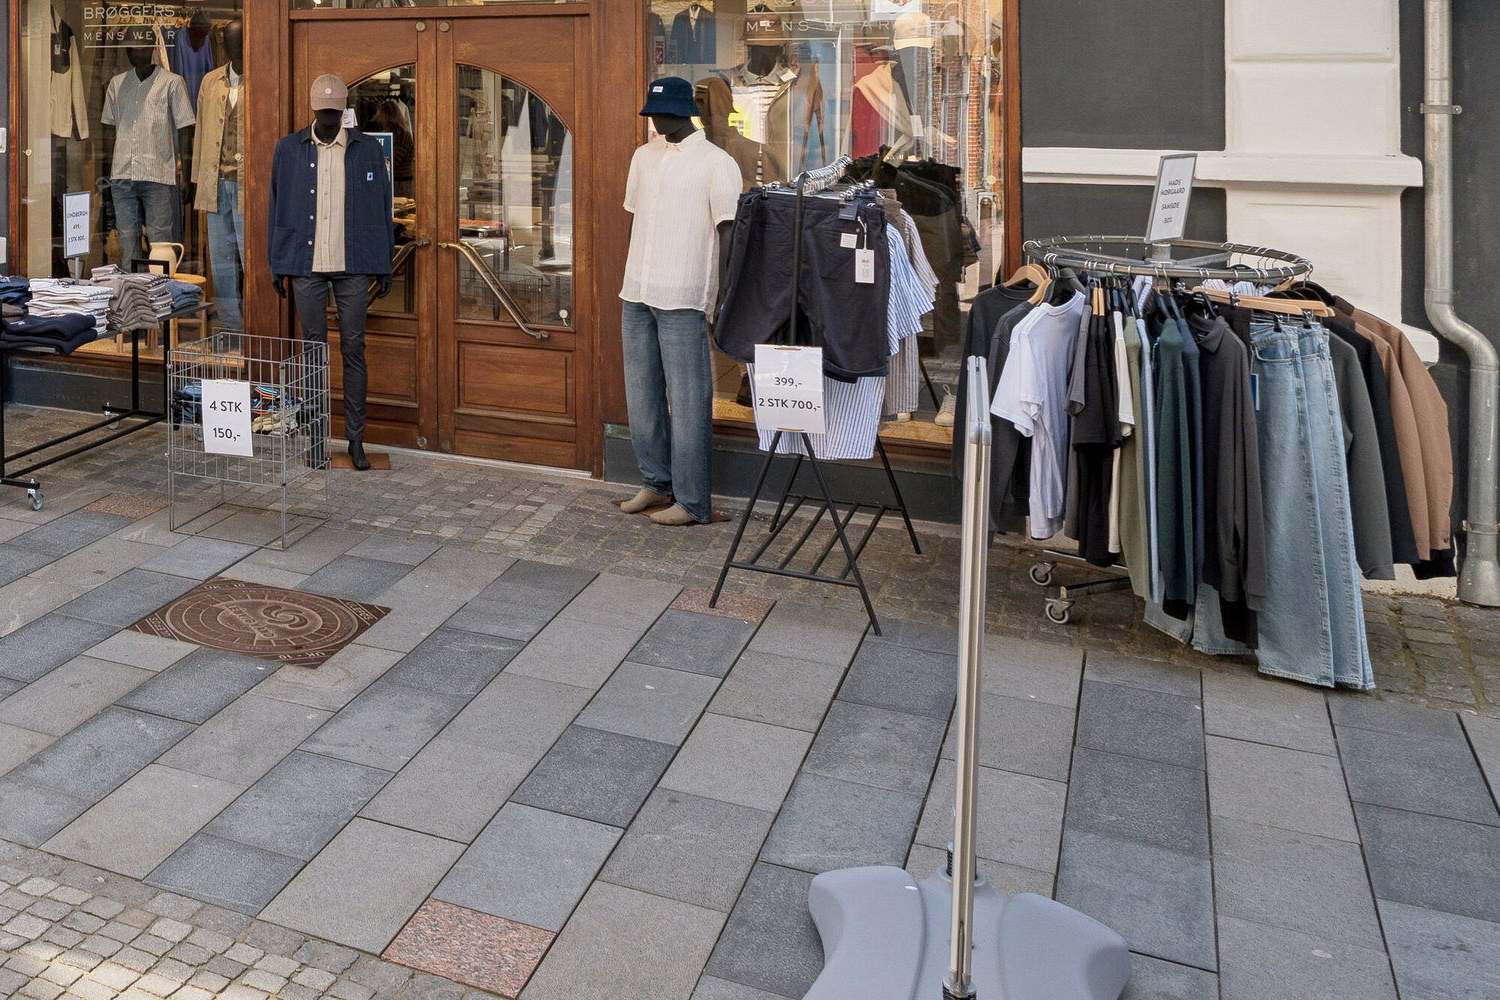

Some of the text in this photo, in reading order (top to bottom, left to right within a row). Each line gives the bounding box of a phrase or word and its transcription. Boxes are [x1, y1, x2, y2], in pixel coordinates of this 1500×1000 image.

[83, 4, 175, 19] BRØGGERS
[746, 19, 890, 33] MENS WEAR
[83, 30, 125, 41] MENS
[774, 377, 803, 389] 399,-
[209, 400, 243, 413] 4 STK
[758, 397, 822, 412] 2 STK 700,-
[212, 427, 241, 442] 150,-
